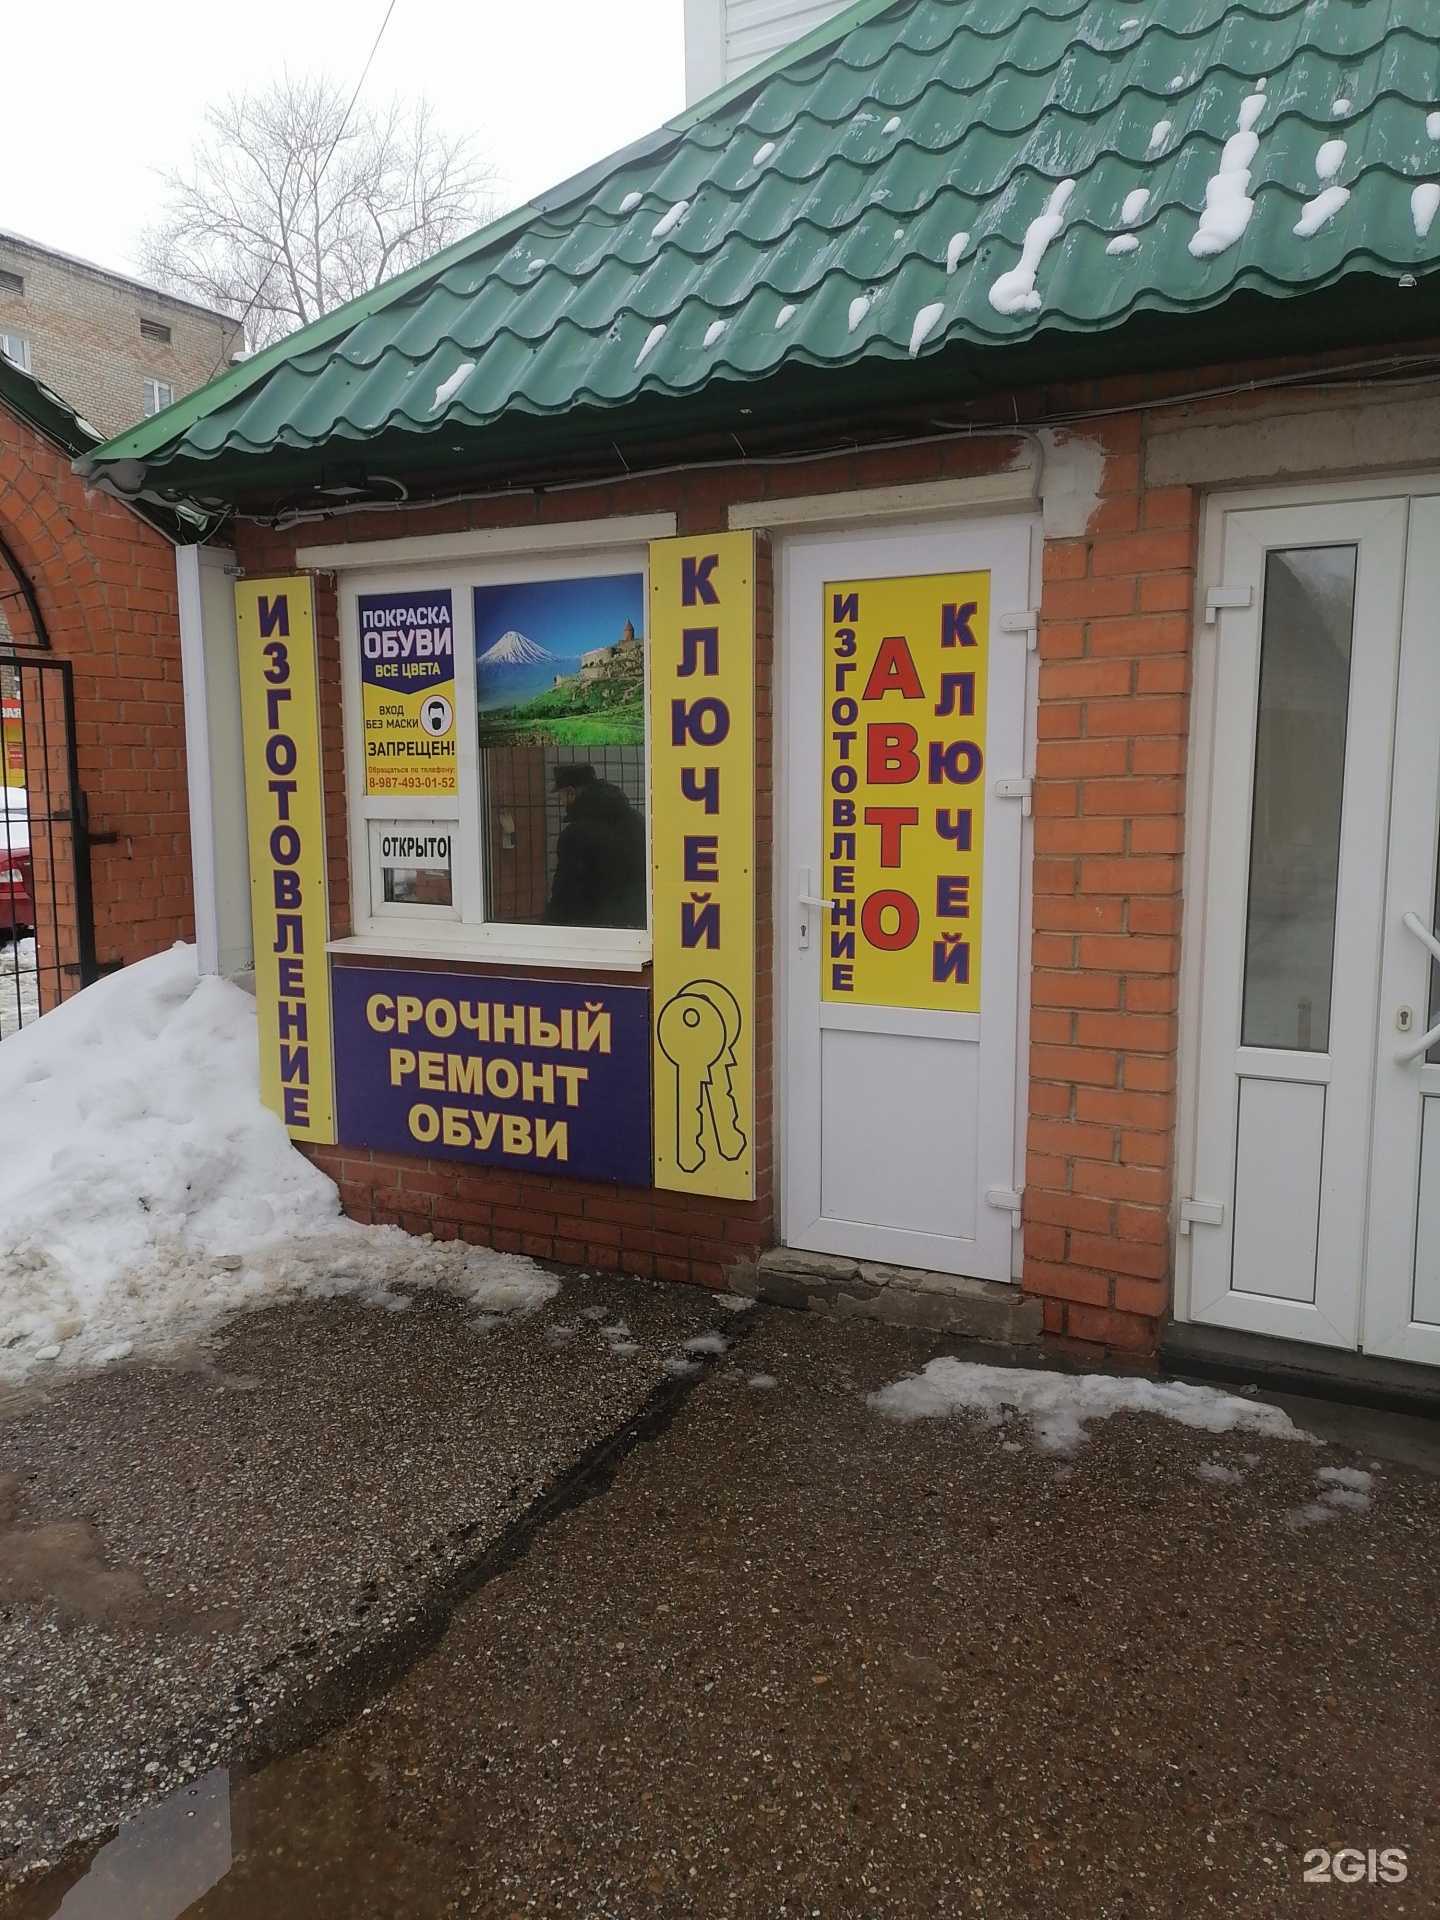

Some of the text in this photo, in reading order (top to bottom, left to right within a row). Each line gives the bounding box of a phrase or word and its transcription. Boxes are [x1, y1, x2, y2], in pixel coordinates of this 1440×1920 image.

[362, 606, 450, 628] ПОКРАСКА
[364, 627, 452, 659] ОБУВИ
[375, 662, 441, 679] ВСЕ ЦВЕТА
[366, 719, 419, 729] БЕЗ МАСКИ
[379, 705, 405, 717] ВХОД
[368, 741, 455, 759] ЗАПРЕЩЕН!
[671, 554, 730, 950] КЛЮЧЕЙ
[368, 766, 409, 775] Обращаться
[369, 777, 456, 789] 8-987-493-01-52
[830, 593, 859, 992] ИЗГОТОВЛЕНИЕ
[861, 636, 926, 951] АВТО
[928, 602, 983, 985] КЛЮЧЕЙ
[256, 594, 310, 1128] ИЗГОТОВЛЕНИЕ
[382, 836, 447, 858] ОТКРЫТО
[365, 993, 612, 1055] СРОЧНЫЙ
[389, 1048, 589, 1107] РЕМОНТ
[408, 1103, 569, 1161] ОБУВИ
